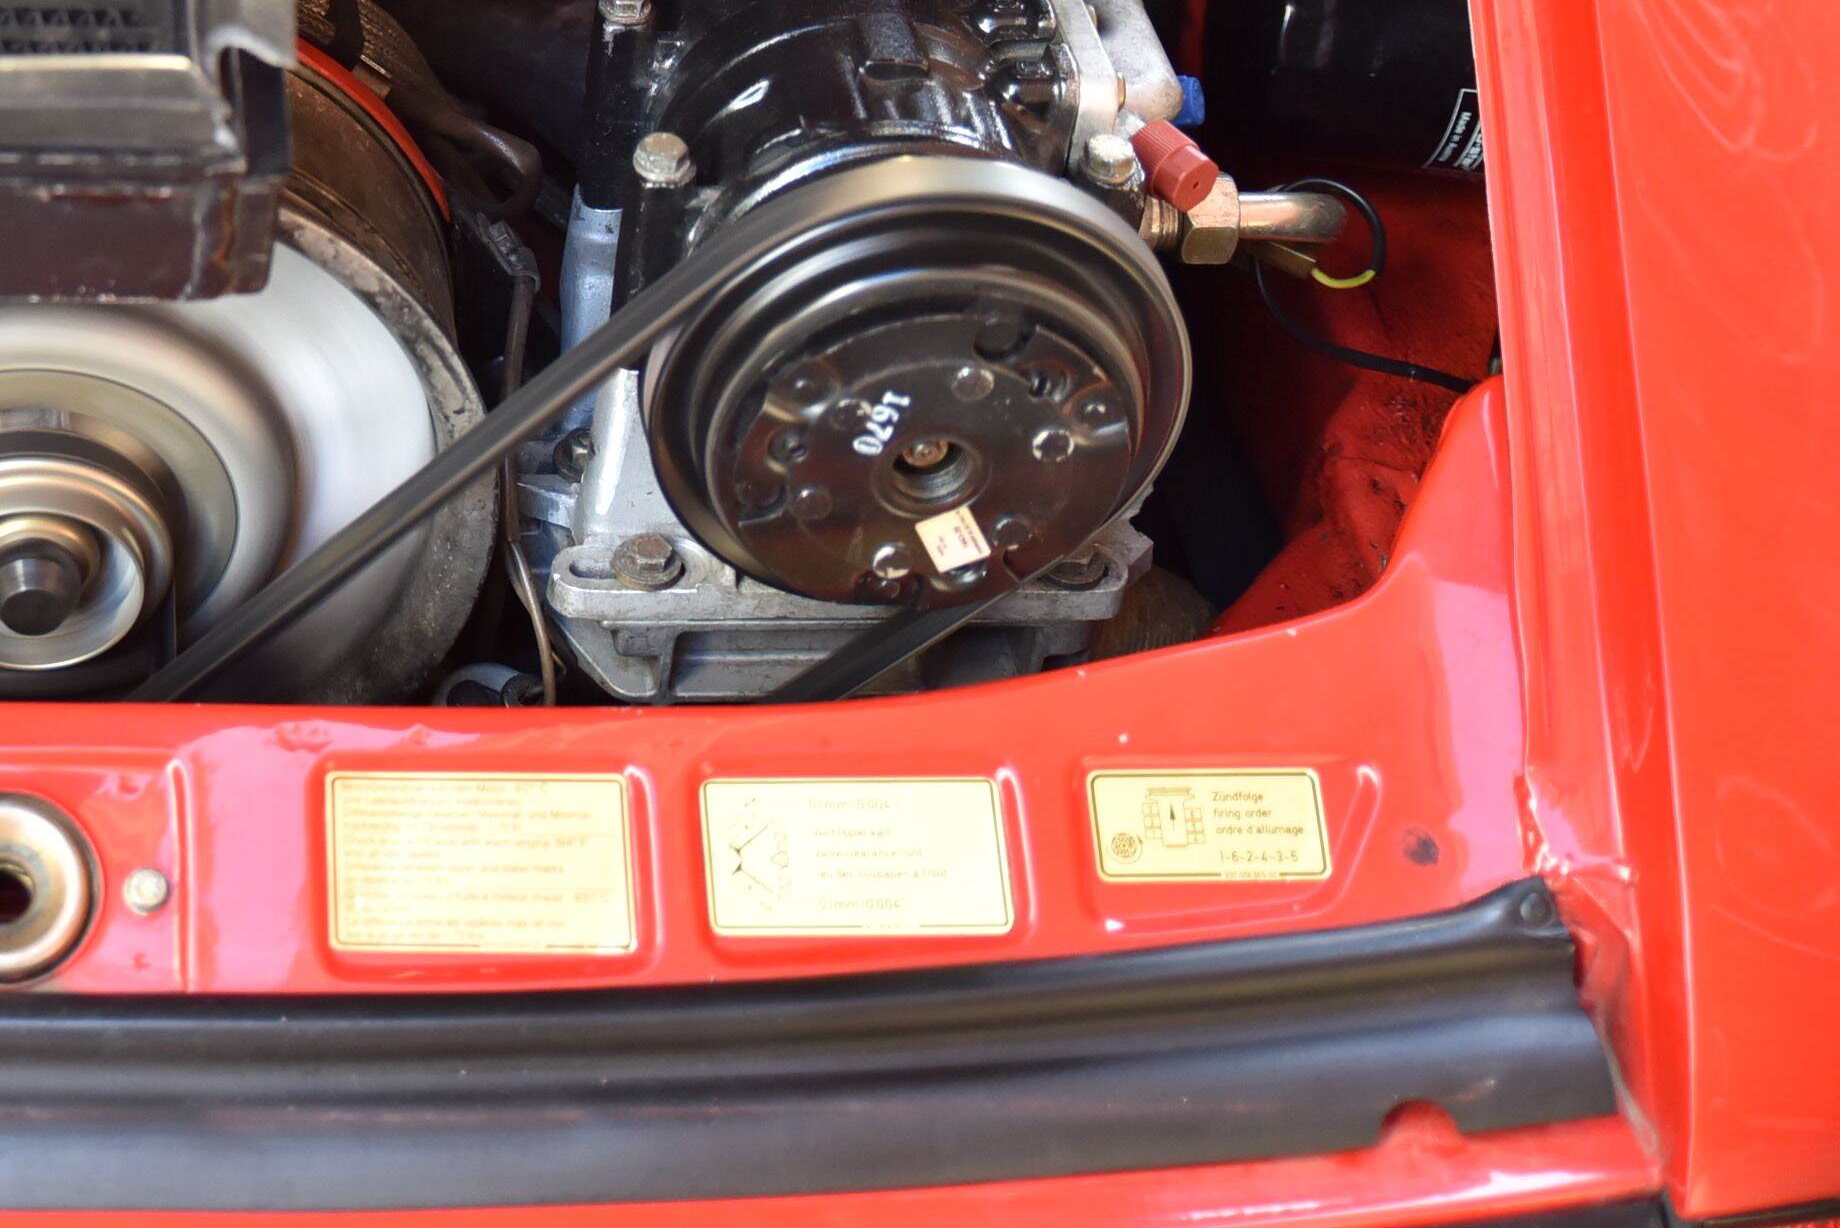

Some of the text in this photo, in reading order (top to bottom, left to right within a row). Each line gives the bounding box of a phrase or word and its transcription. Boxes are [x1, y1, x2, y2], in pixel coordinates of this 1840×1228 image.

[852, 389, 911, 456] 1670
[1213, 808, 1272, 821] firing order
[1216, 825, 1243, 835] ordre
[1219, 850, 1299, 863] 1-6-2-4-3-5
